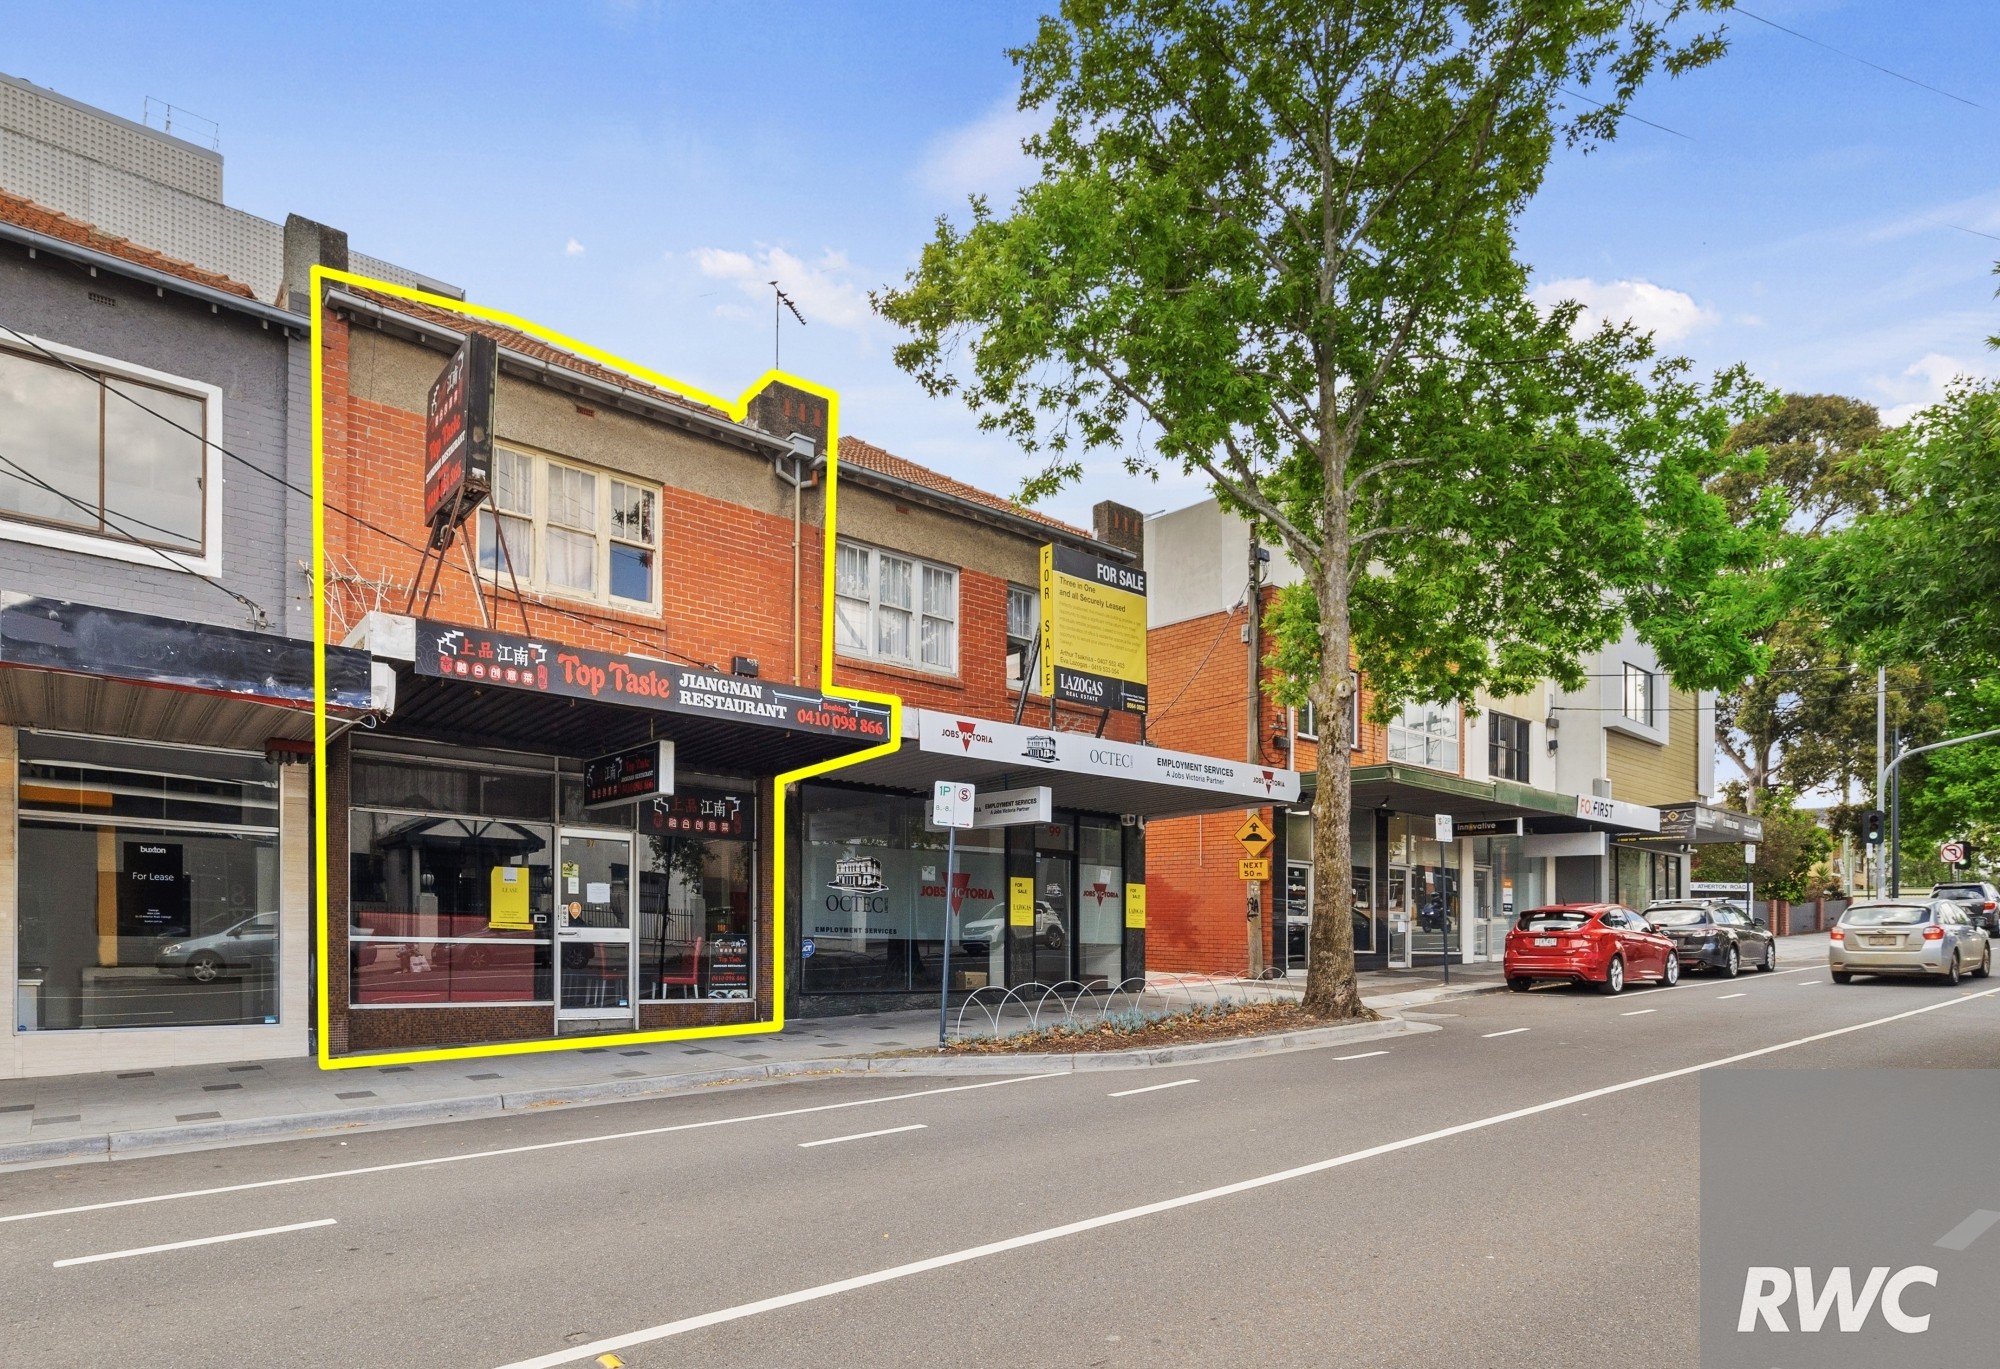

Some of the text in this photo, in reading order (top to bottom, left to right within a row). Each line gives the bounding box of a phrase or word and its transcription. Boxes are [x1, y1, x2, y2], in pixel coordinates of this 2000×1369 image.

[1060, 576, 1076, 588] Three
[1084, 584, 1096, 593] One
[1097, 563, 1144, 591] FOR SALE
[1059, 589, 1071, 598] and
[1080, 594, 1105, 608] Securely
[1106, 601, 1126, 612] Leased
[460, 637, 528, 667] 上品江南
[557, 653, 606, 696] Top
[608, 661, 670, 698] Taste
[679, 673, 762, 699] JIANGNAN
[1060, 674, 1103, 696] LAZOGAS
[679, 690, 787, 719] RESTAURANT
[1081, 694, 1098, 702] ESTATE
[797, 709, 884, 735] 0410 098 866
[942, 729, 993, 743] JOBS VICTORIA
[1089, 749, 1130, 768] OCTEC
[1157, 757, 1234, 777] EMPLOYMENT SERVICES
[1172, 771, 1185, 779] Jobs
[1186, 774, 1205, 782] Victoria
[1206, 776, 1225, 785] Partner
[940, 786, 951, 796] 1P
[985, 798, 1037, 809] EMPLOYMENT SERVICES
[1457, 822, 1496, 832] innovative
[140, 846, 166, 854] buxton
[132, 872, 174, 881] For Lease
[920, 886, 946, 897] JOBS
[826, 894, 883, 913] OCTEC
[815, 926, 862, 934] EMPLOYMENT
